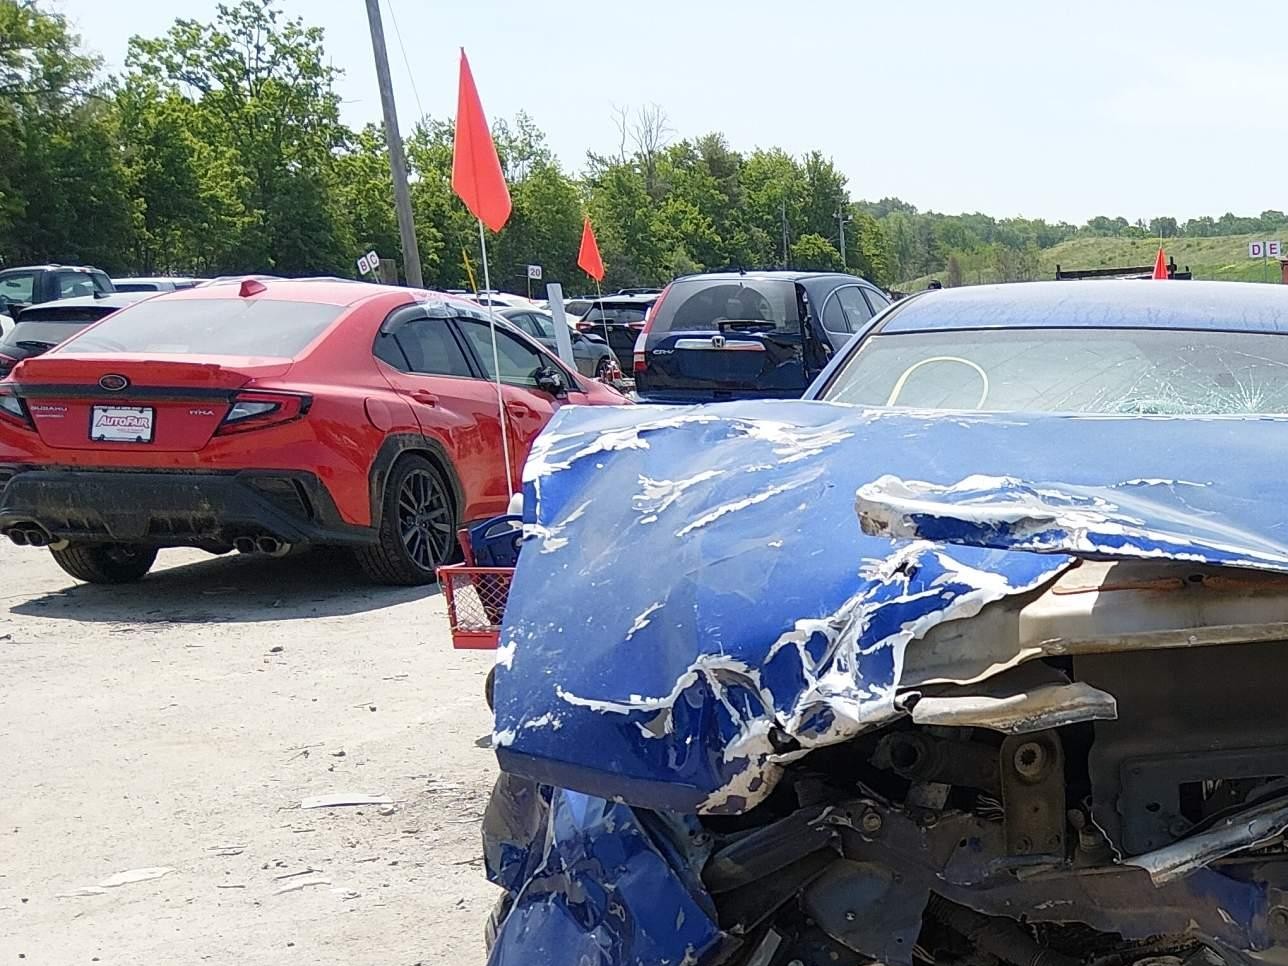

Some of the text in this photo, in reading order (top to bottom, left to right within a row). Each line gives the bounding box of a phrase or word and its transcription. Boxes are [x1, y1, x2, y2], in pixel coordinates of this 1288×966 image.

[1252, 244, 1261, 256] D
[1270, 243, 1278, 255] E
[369, 254, 378, 265] C
[359, 260, 368, 271] B
[530, 267, 541, 277] 20
